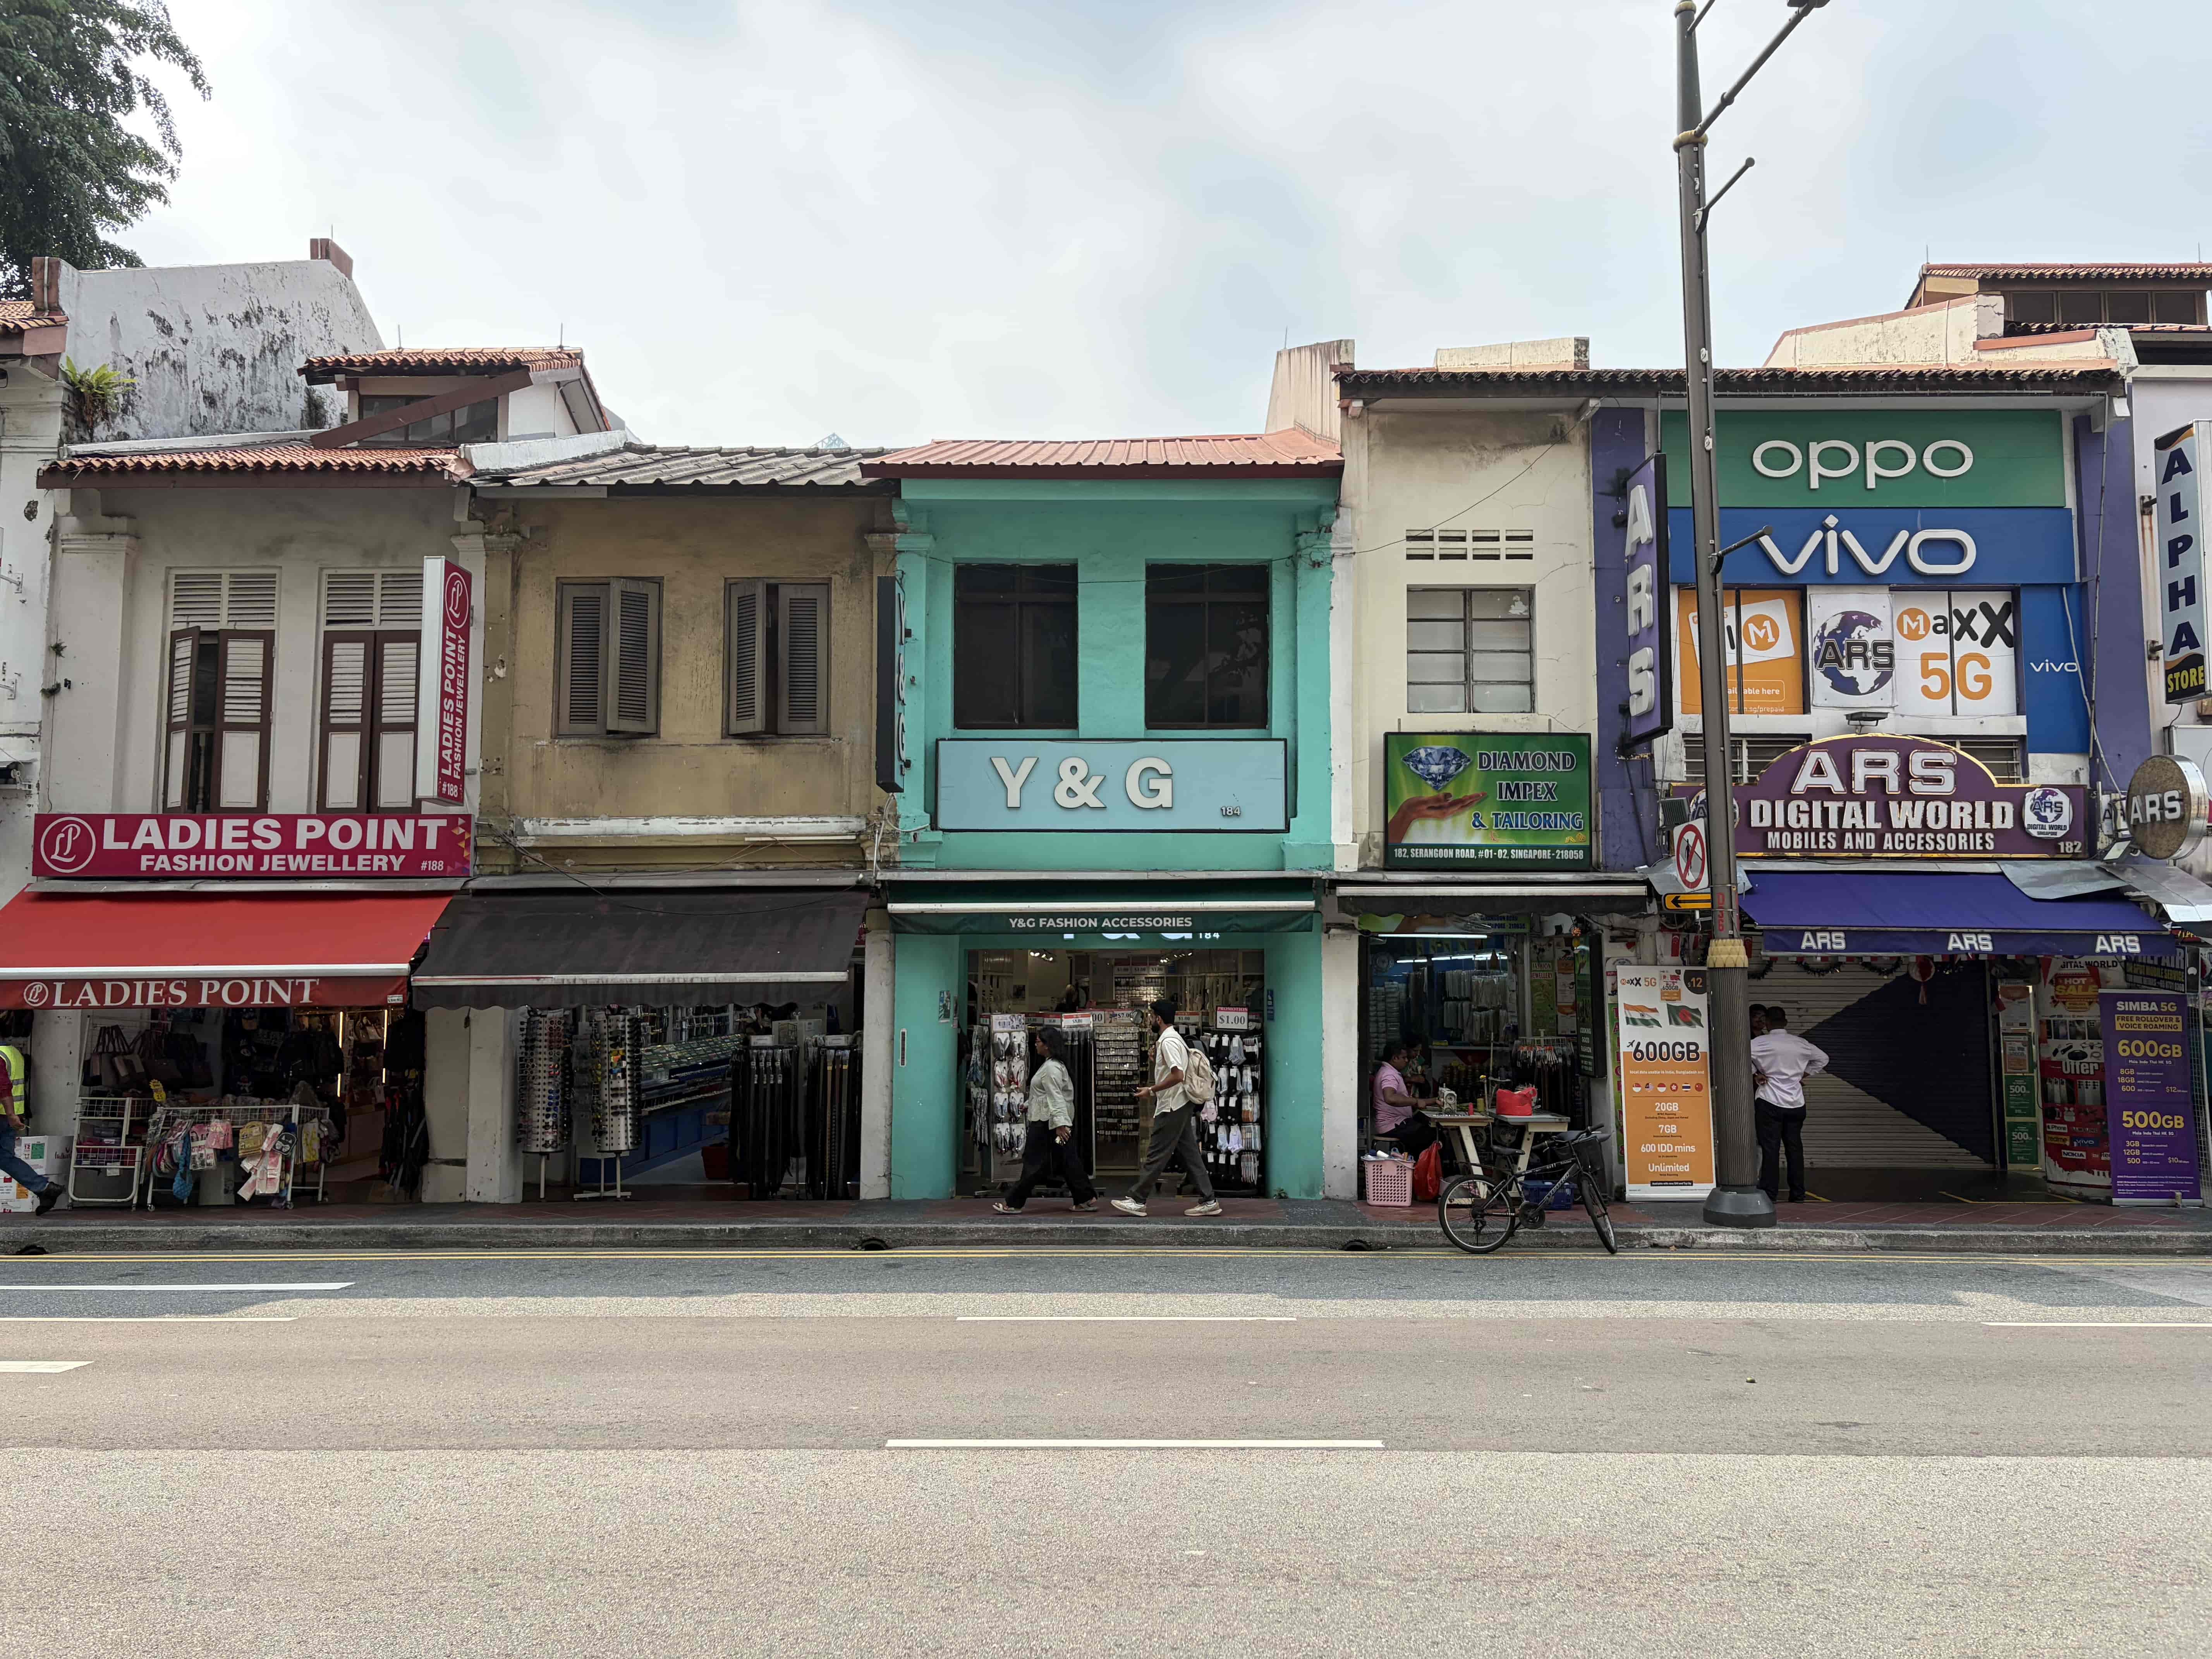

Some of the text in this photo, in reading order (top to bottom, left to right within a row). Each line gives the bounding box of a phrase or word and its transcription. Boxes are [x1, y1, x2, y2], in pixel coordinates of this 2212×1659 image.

[1753, 440, 1973, 489] oppo
[1755, 514, 1977, 575] vivo
[2161, 447, 2201, 656] ALPHA
[1625, 484, 1655, 717] ARS
[1815, 639, 1894, 670] ARS
[2030, 659, 2078, 672] vivo
[1920, 652, 1992, 701] 5G
[2167, 665, 2204, 693] STORE
[441, 627, 457, 775] LADIES POINT
[453, 638, 466, 779] FASHION JEWELLERY
[1477, 751, 1576, 771] DIAMOND
[1790, 748, 1958, 795] ARS
[442, 781, 458, 798] #188
[990, 756, 1173, 809] Y & G
[1497, 781, 1558, 802] IMPEX
[1220, 806, 1242, 817] 184
[1750, 799, 2014, 830] DIGITAL WORLD
[2032, 800, 2063, 813] ARS
[2130, 789, 2183, 825] ARS
[1471, 812, 1583, 830] & TAILORING
[103, 818, 448, 850] LADIES POINT
[1768, 831, 1995, 850] MOBILES AND ACCESSORIES
[1395, 848, 1409, 859] 182,
[1410, 848, 1455, 859] SERANGOON
[1455, 849, 1477, 859] ROAD,
[2058, 841, 2082, 853] 182
[141, 854, 444, 871] FASHION JEWELLERY #188
[1009, 917, 1192, 928] Y&G FASHION ACCESSORIES
[1800, 931, 1846, 950] ARS
[1947, 933, 1993, 952] ARS
[2095, 935, 2141, 954] ARS
[2061, 960, 2084, 969] GITAL
[1644, 977, 1657, 987] 5G
[2055, 985, 2098, 995] SALE
[53, 979, 320, 1006] LADIES POINT
[2116, 1001, 2177, 1012] SIMBA 5G
[1219, 1015, 1245, 1025] $1.00
[1632, 1041, 1701, 1063] 600GB
[2118, 1039, 2182, 1058] 600GB
[1655, 1103, 1679, 1111] 20GB
[1658, 1125, 1677, 1133] 7GB
[2122, 1111, 2185, 1128] 500GB
[1641, 1143, 1696, 1152] 600 IDD mins
[1648, 1163, 1690, 1172] Unlimited
